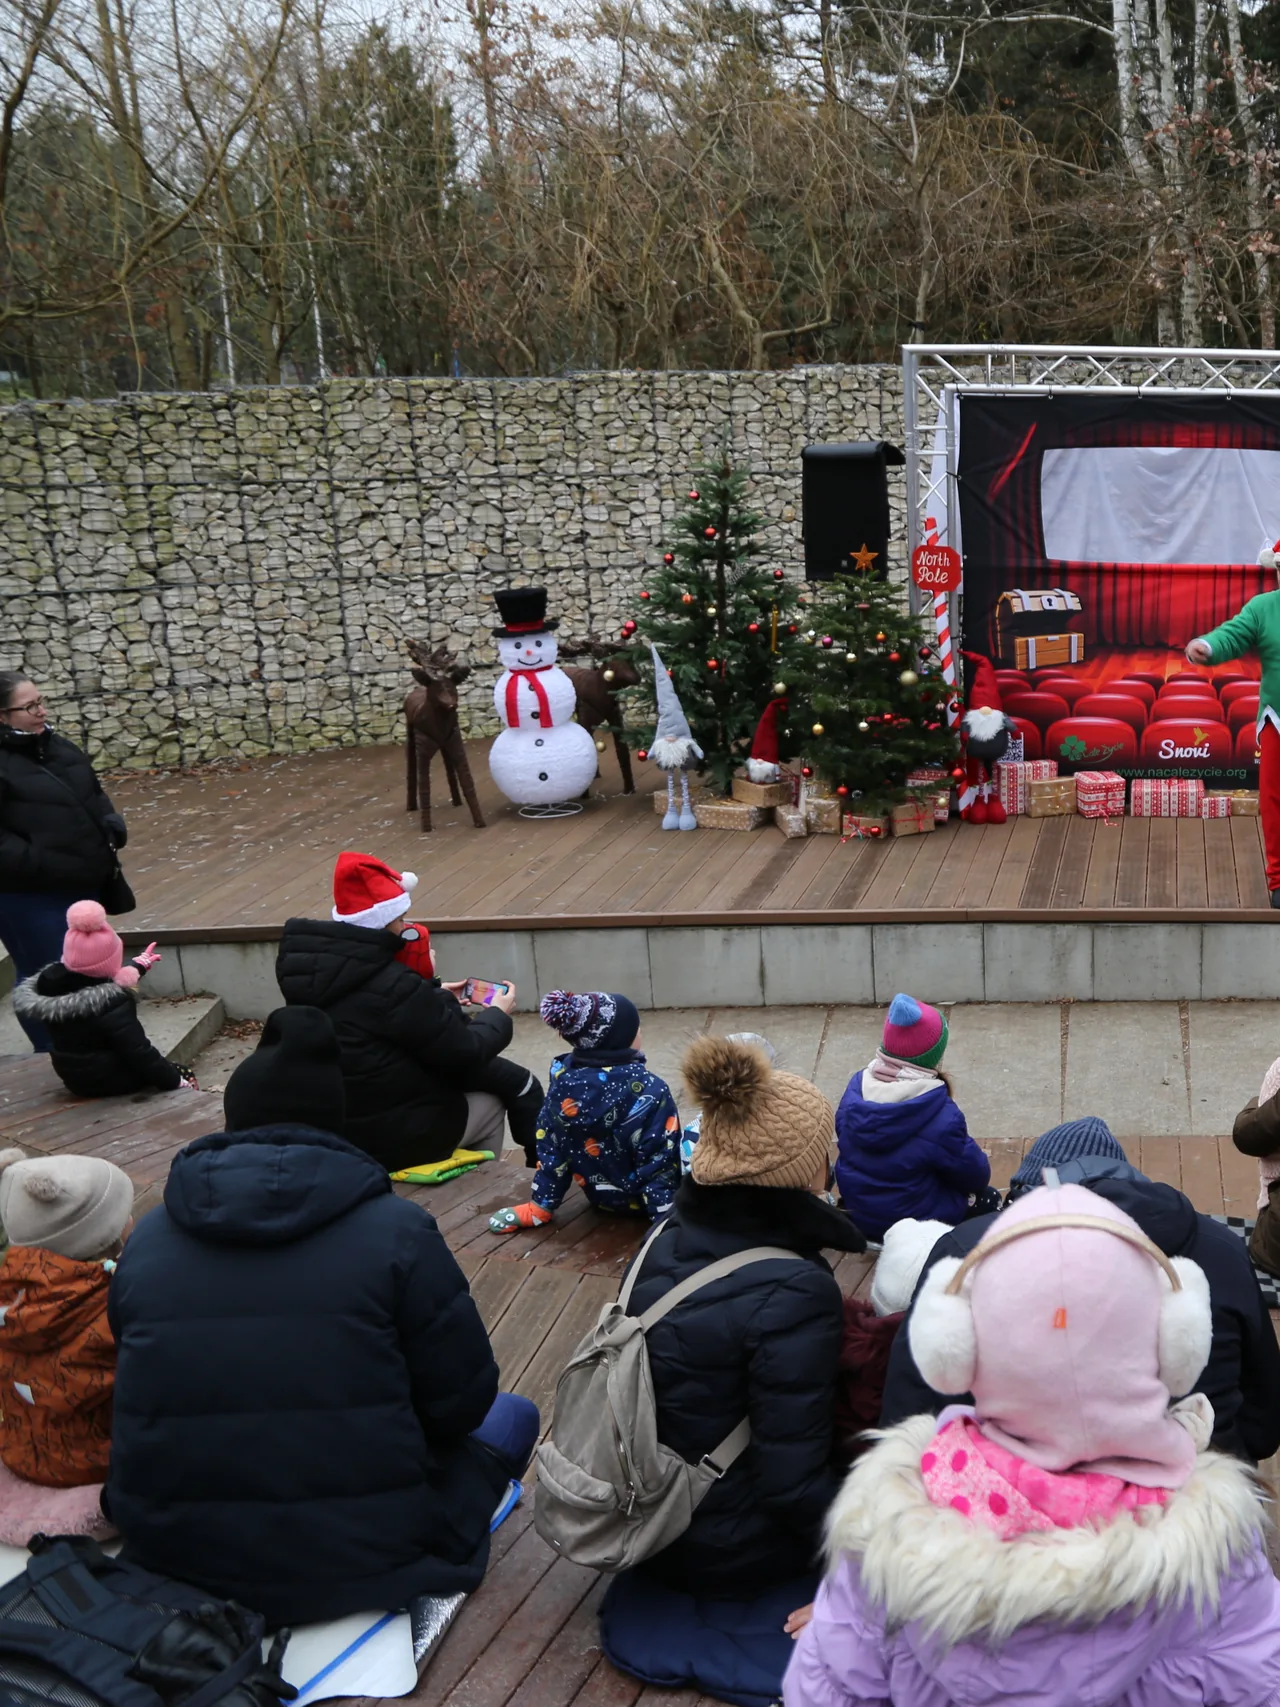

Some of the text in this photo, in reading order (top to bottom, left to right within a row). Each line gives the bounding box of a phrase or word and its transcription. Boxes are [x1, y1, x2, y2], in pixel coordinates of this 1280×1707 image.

[917, 551, 950, 566] North
[917, 566, 949, 584] Pole
[1159, 739, 1211, 759] Snovi
